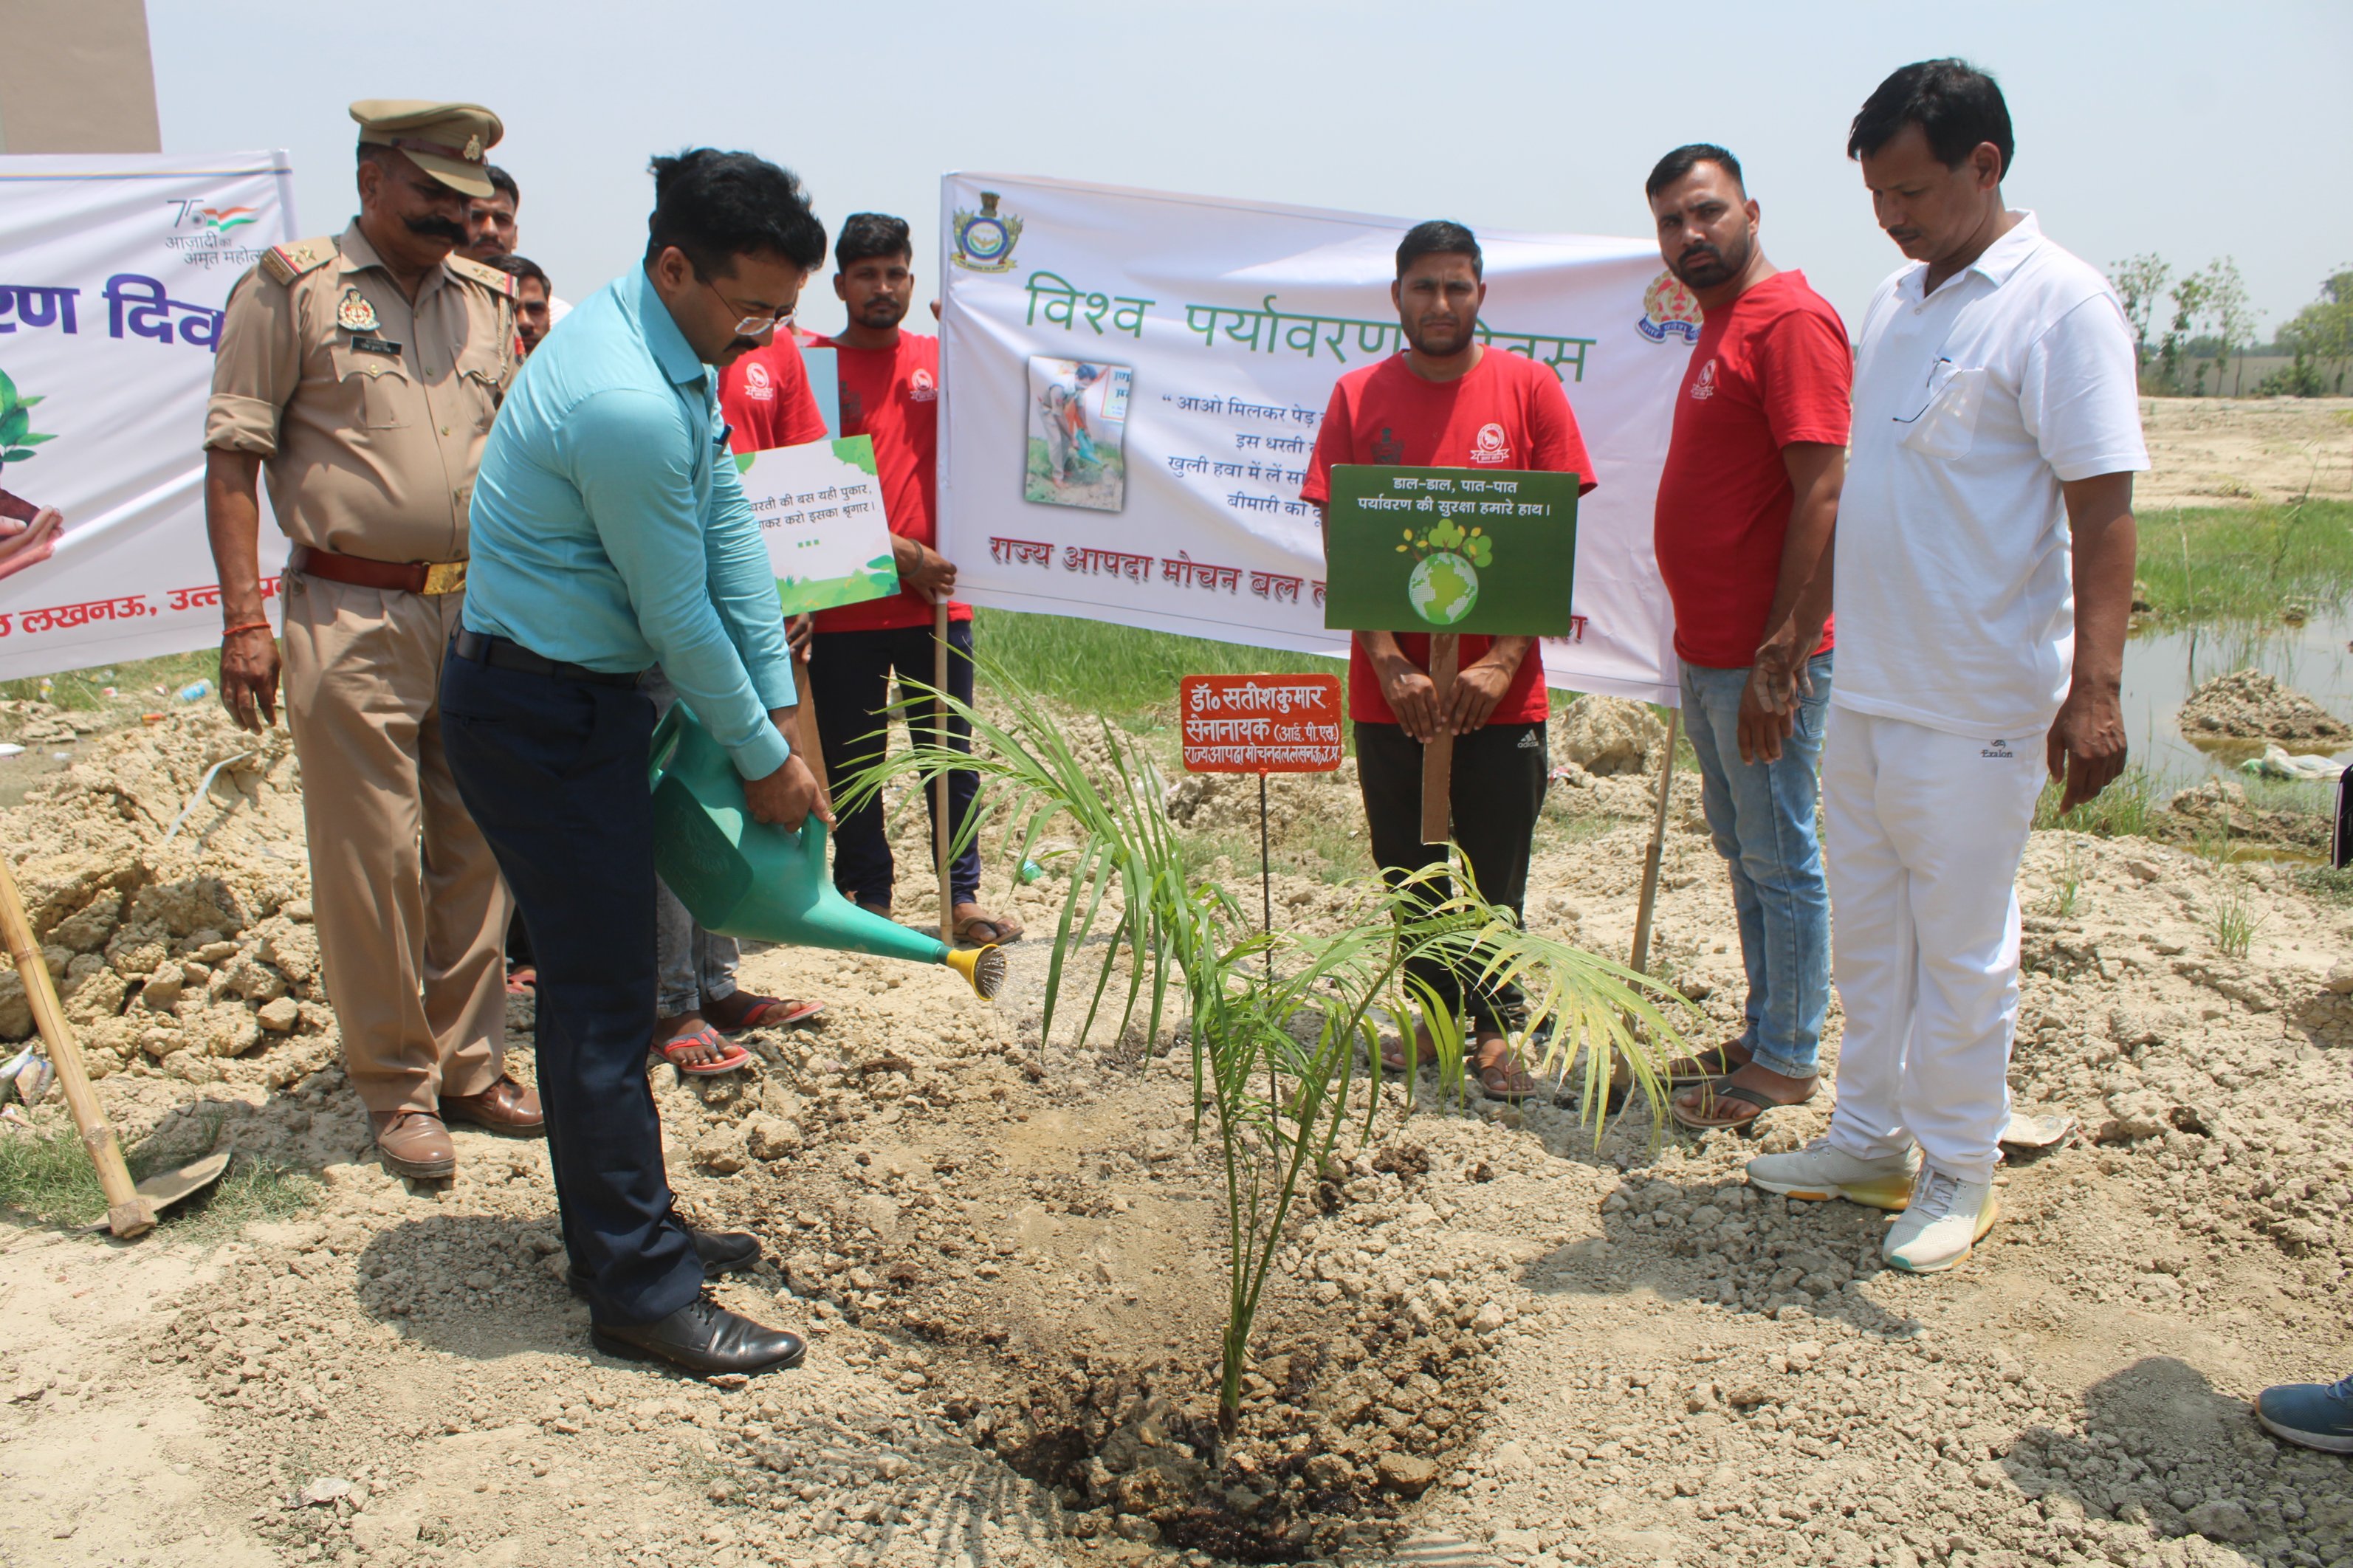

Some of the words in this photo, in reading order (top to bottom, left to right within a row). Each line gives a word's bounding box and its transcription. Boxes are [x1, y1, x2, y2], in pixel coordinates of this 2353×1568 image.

[184, 251, 219, 269] अमृत
[1025, 271, 1155, 340] विश्व
[1185, 295, 1403, 364] पर्यावरण
[1228, 396, 1287, 422] मिलकर
[1292, 404, 1316, 428] पेड़
[1236, 433, 1260, 450] इस
[1266, 436, 1308, 453] धरती
[1168, 455, 1209, 477] खुली
[1213, 462, 1243, 478] हवा
[1248, 461, 1262, 479] में
[1265, 463, 1282, 482] लें
[1286, 469, 1306, 484] सां
[780, 494, 793, 507] की
[797, 493, 814, 503] बस
[818, 486, 837, 500] यही
[1227, 491, 1280, 513] बीमारी
[1358, 493, 1412, 511] पर्यावरण
[1416, 496, 1434, 512] की
[1438, 500, 1476, 517] सुरक्षा
[1480, 499, 1514, 515] हमारे
[785, 510, 805, 525] करो
[808, 507, 838, 523] इसका
[989, 537, 1054, 565] राज्य
[1063, 546, 1153, 580] आपदा
[1162, 551, 1242, 591] मोचन
[1251, 570, 1303, 599] बल
[19, 594, 157, 633] लखनऊ,
[1186, 713, 1271, 742] सेनानायक
